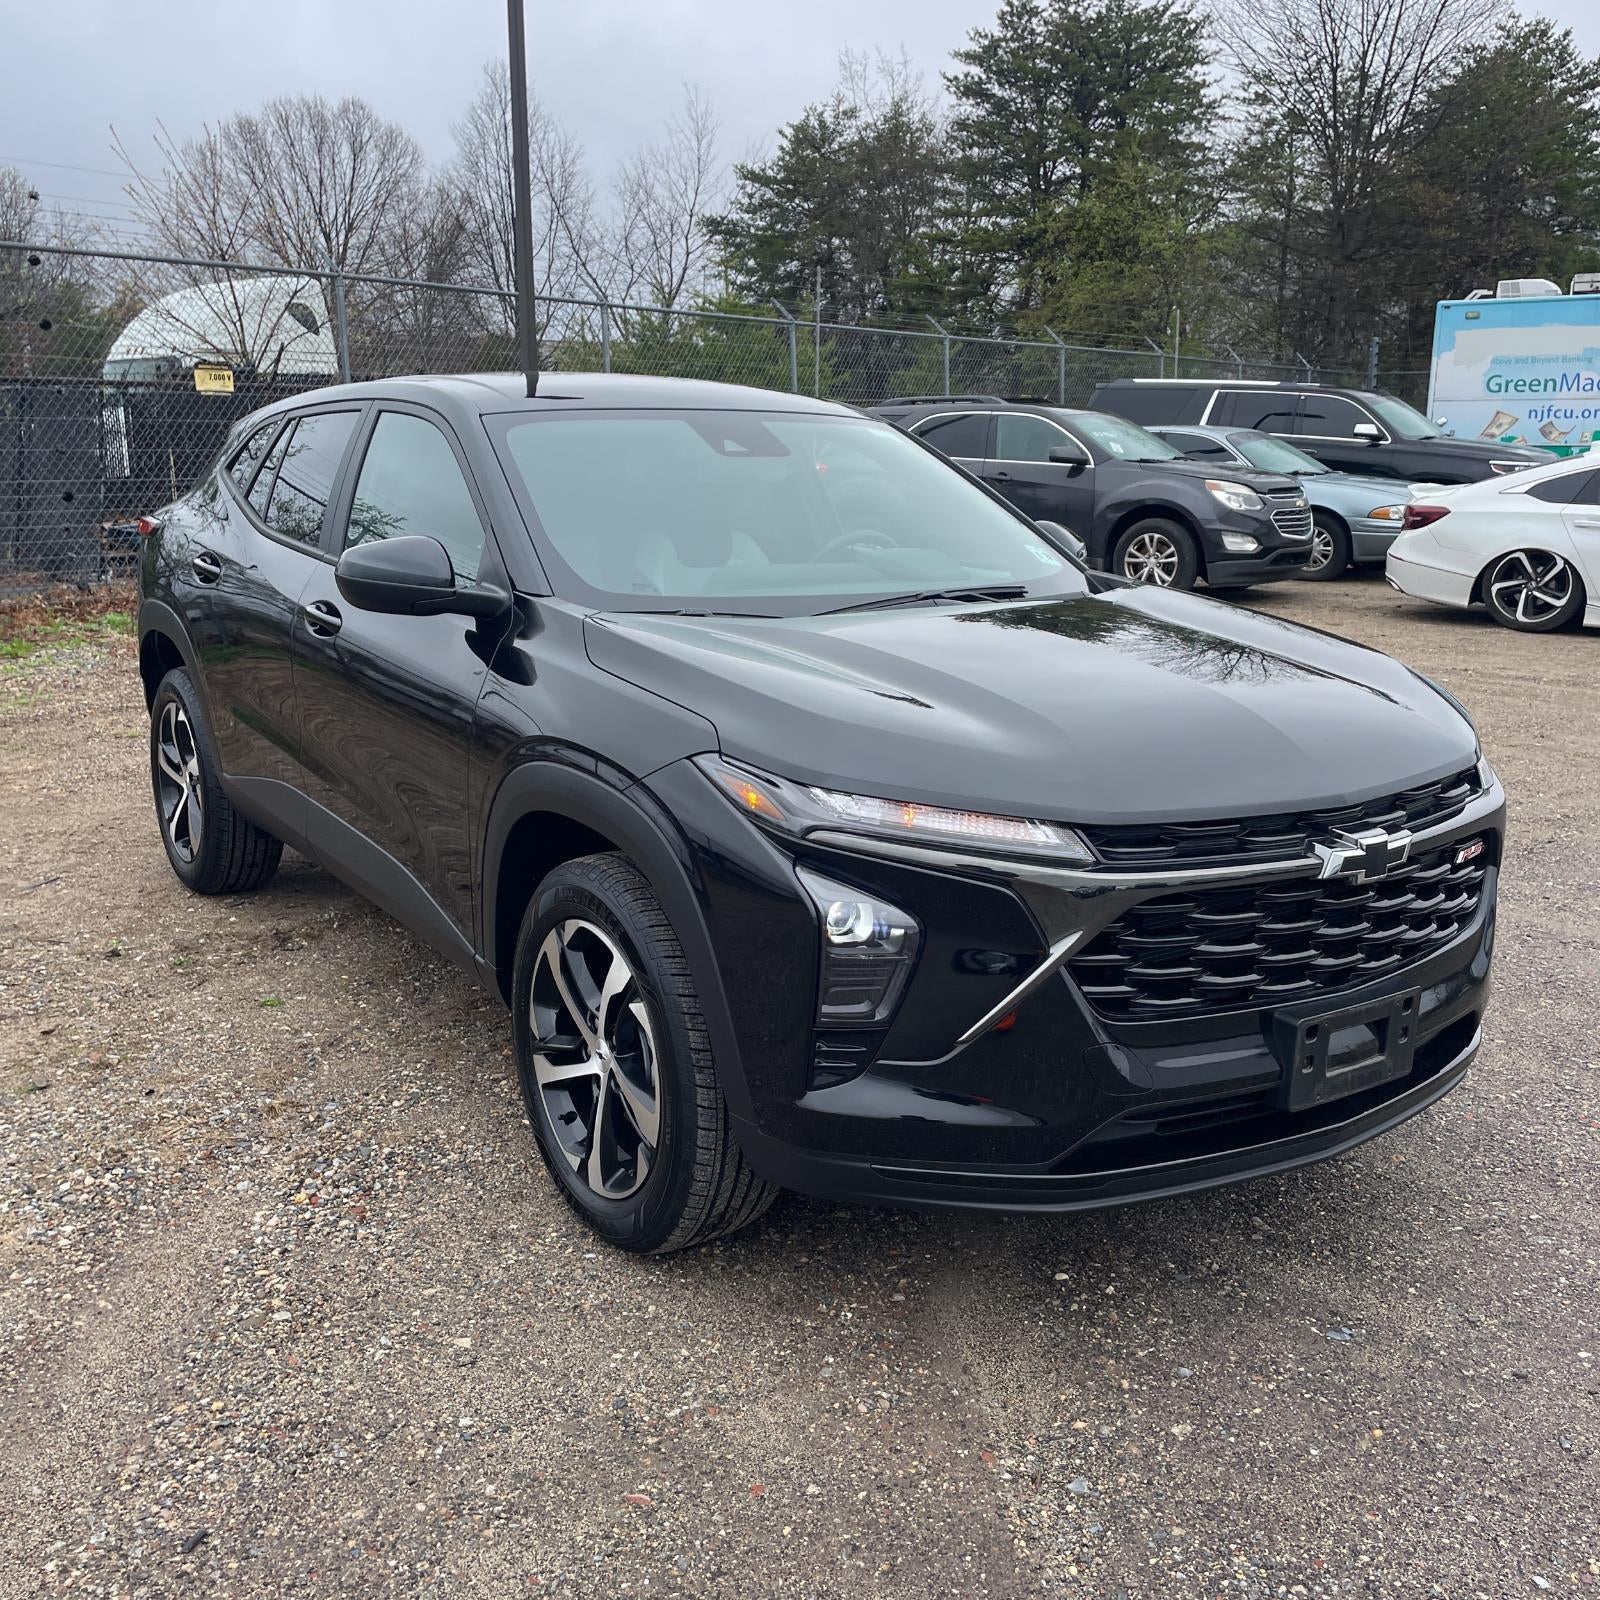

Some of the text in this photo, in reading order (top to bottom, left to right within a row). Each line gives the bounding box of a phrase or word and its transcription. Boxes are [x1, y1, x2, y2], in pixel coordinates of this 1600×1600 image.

[1514, 356, 1529, 365] and
[1531, 356, 1559, 366] Beyond
[1562, 354, 1594, 365] Banking
